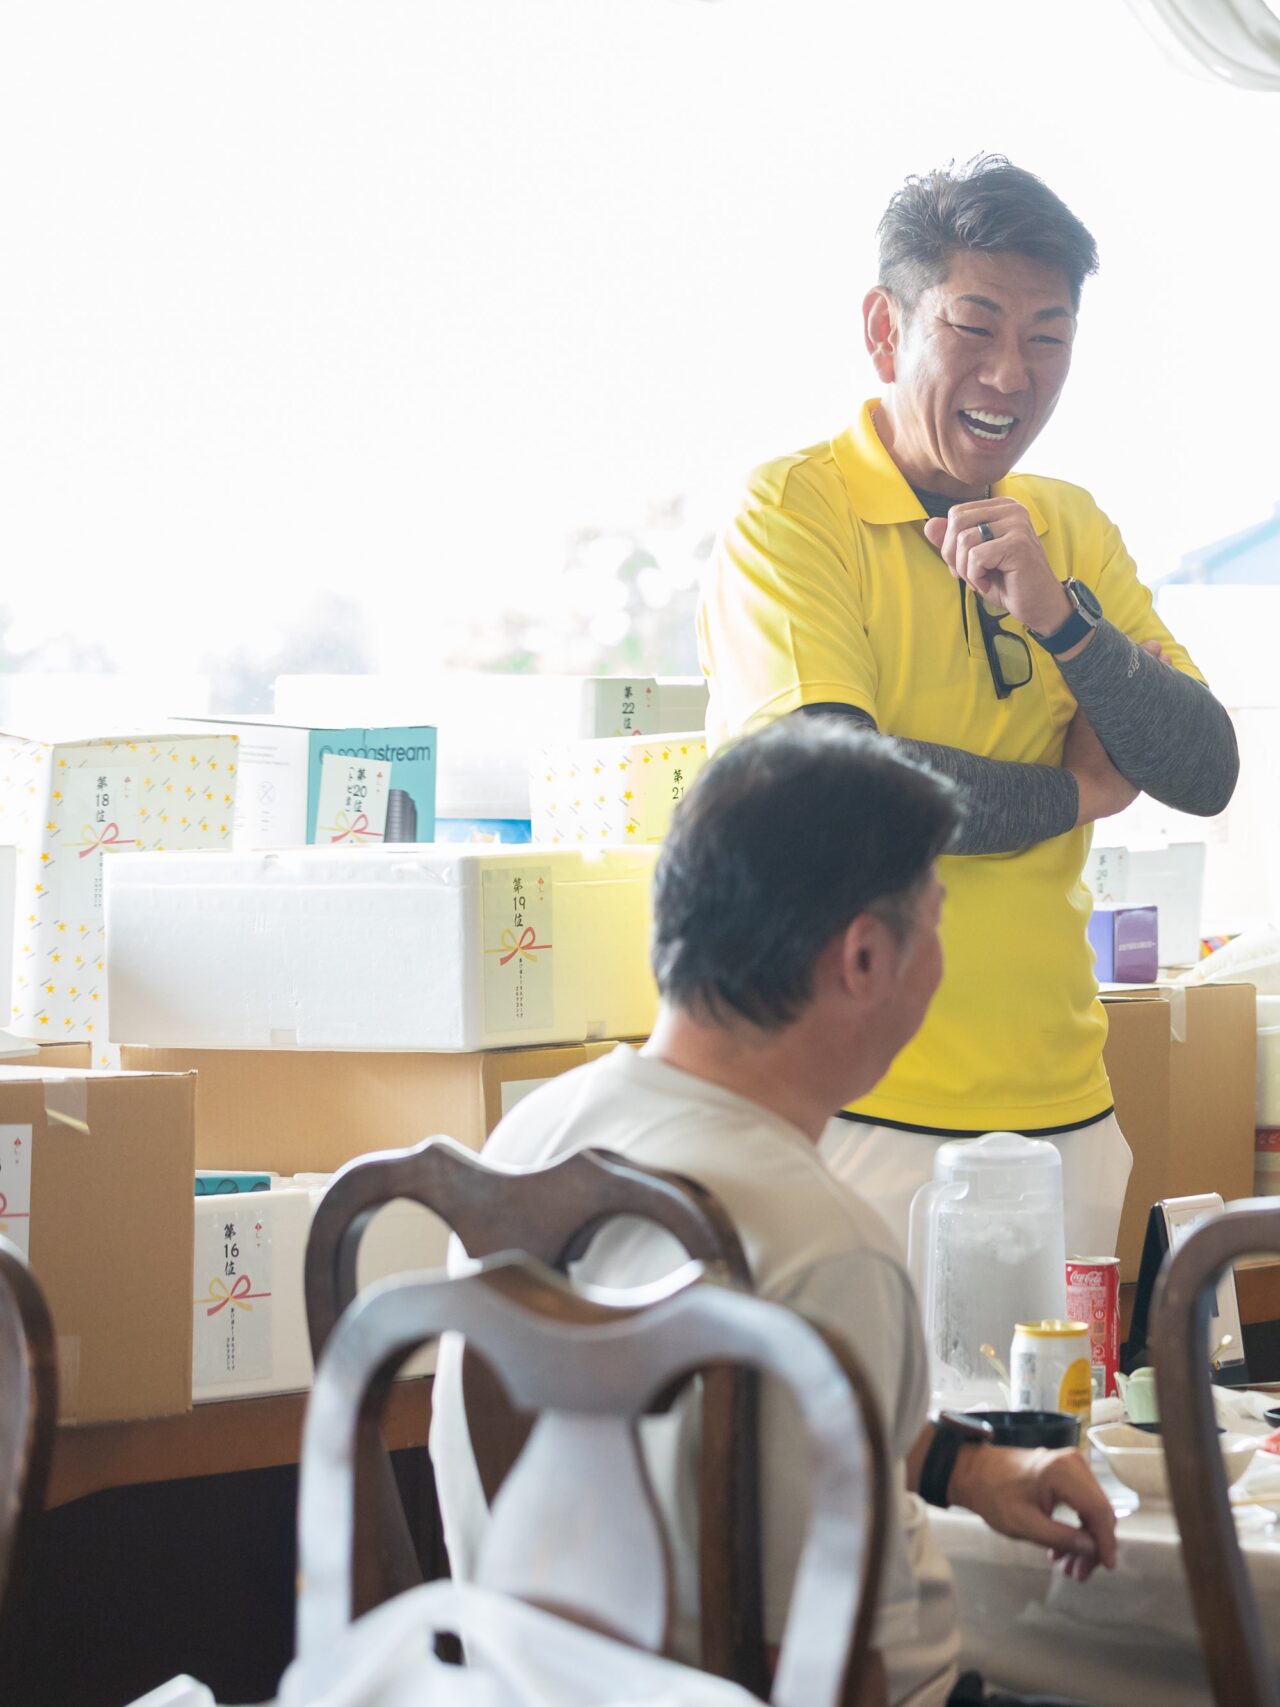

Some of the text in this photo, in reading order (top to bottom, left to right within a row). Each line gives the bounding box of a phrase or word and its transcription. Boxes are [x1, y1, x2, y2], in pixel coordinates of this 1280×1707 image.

[622, 685, 635, 729] 第22位
[96, 776, 110, 823] 第18位
[353, 767, 368, 813] 第20位
[513, 877, 526, 928] 第19位
[224, 1222, 240, 1277] 第16位
